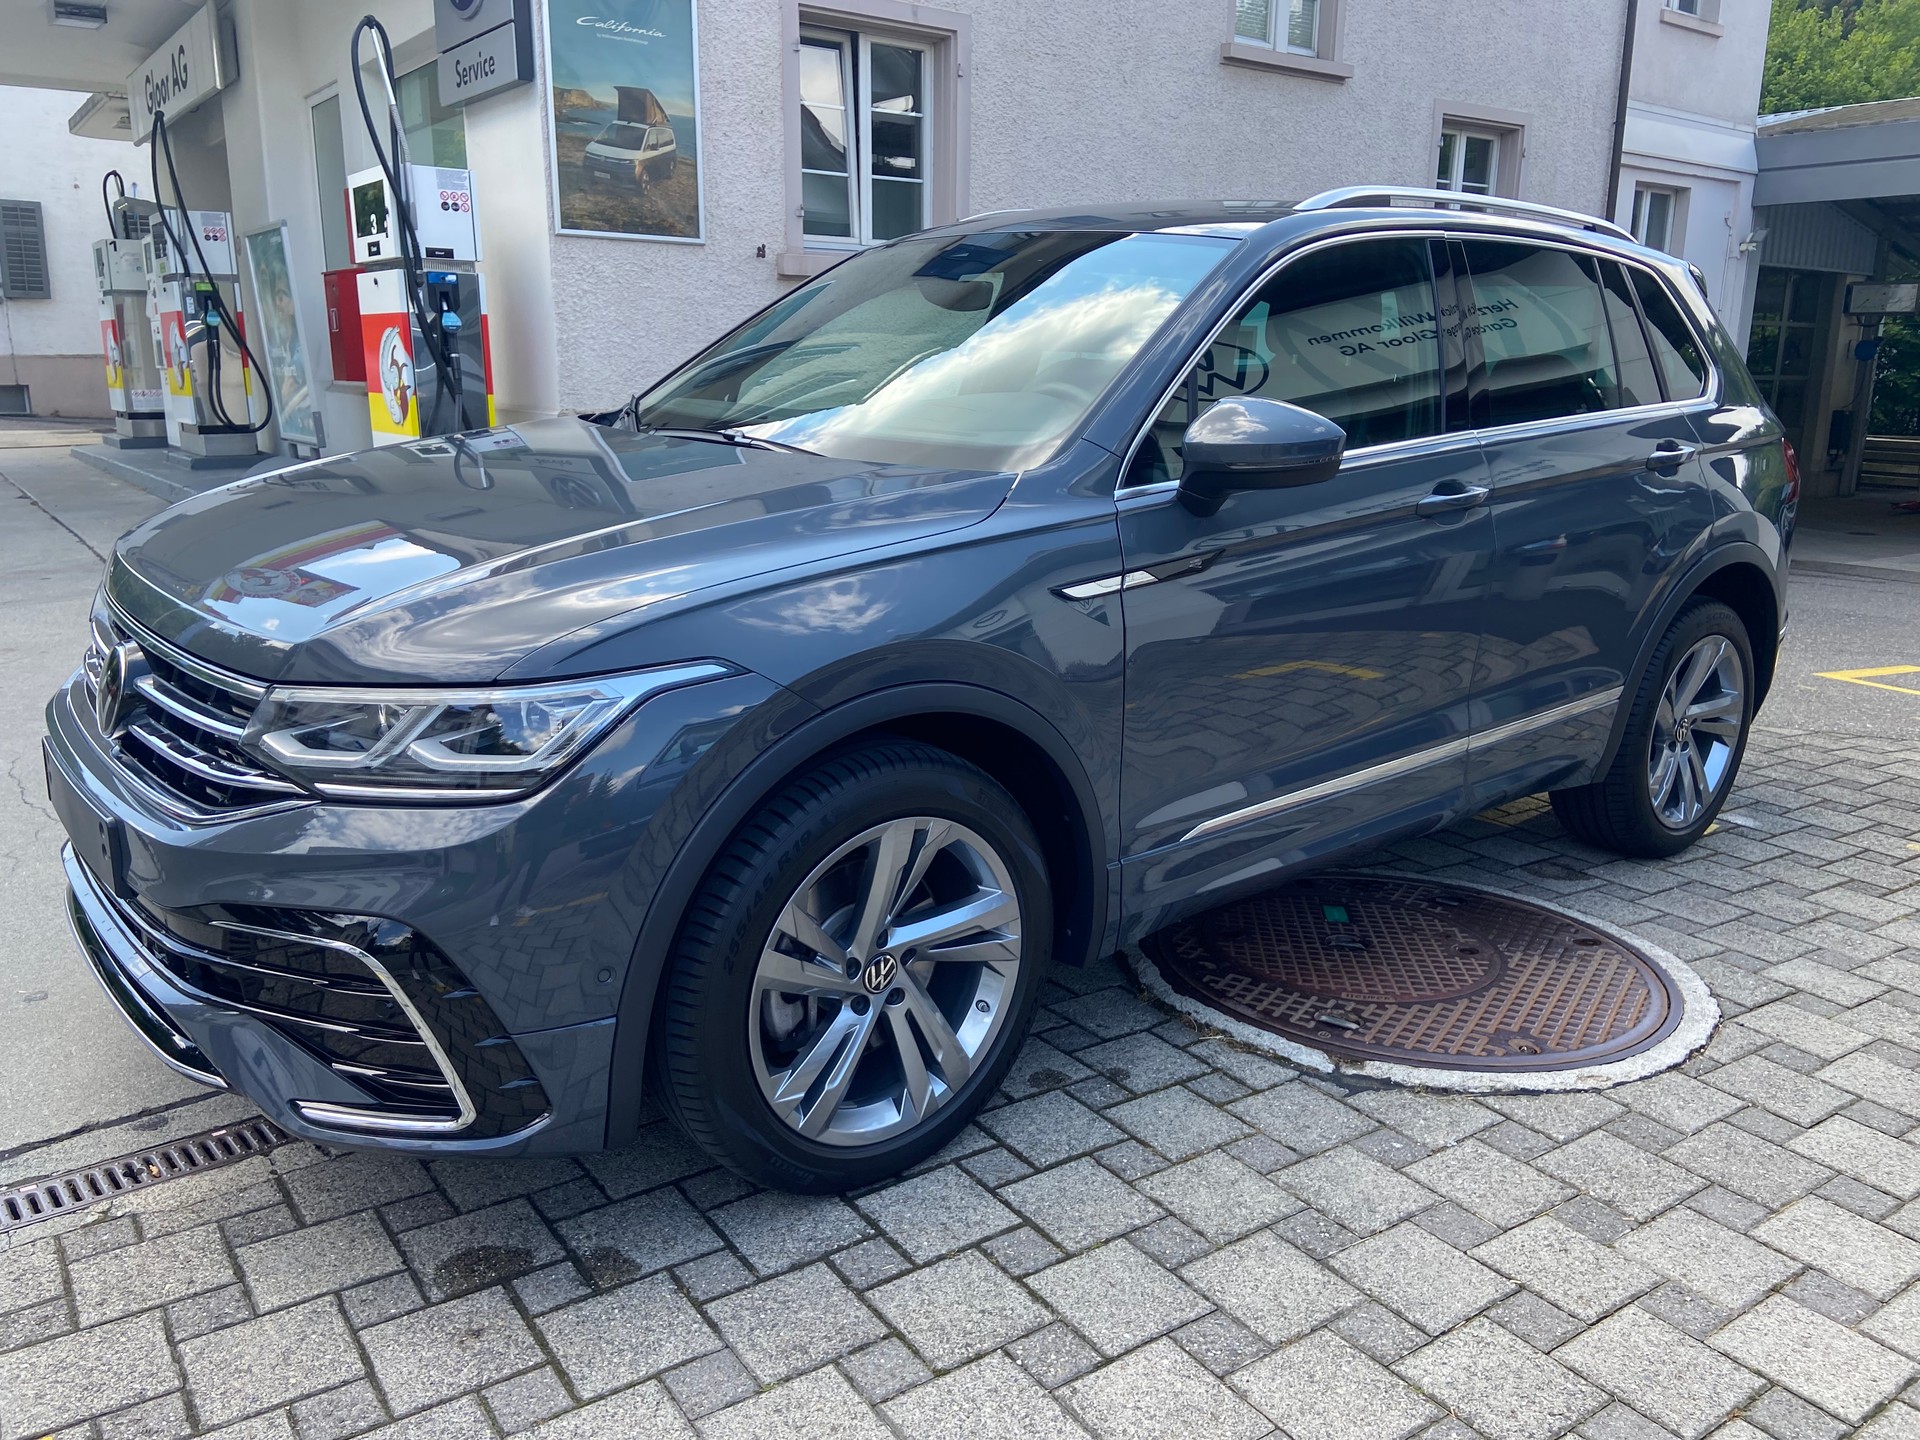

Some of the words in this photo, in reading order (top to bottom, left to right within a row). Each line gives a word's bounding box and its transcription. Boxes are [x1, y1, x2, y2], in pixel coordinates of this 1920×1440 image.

[576, 16, 667, 38] California
[144, 69, 170, 116] Gloor
[171, 44, 188, 97] AG
[455, 51, 495, 88] Service
[370, 213, 378, 235] 3
